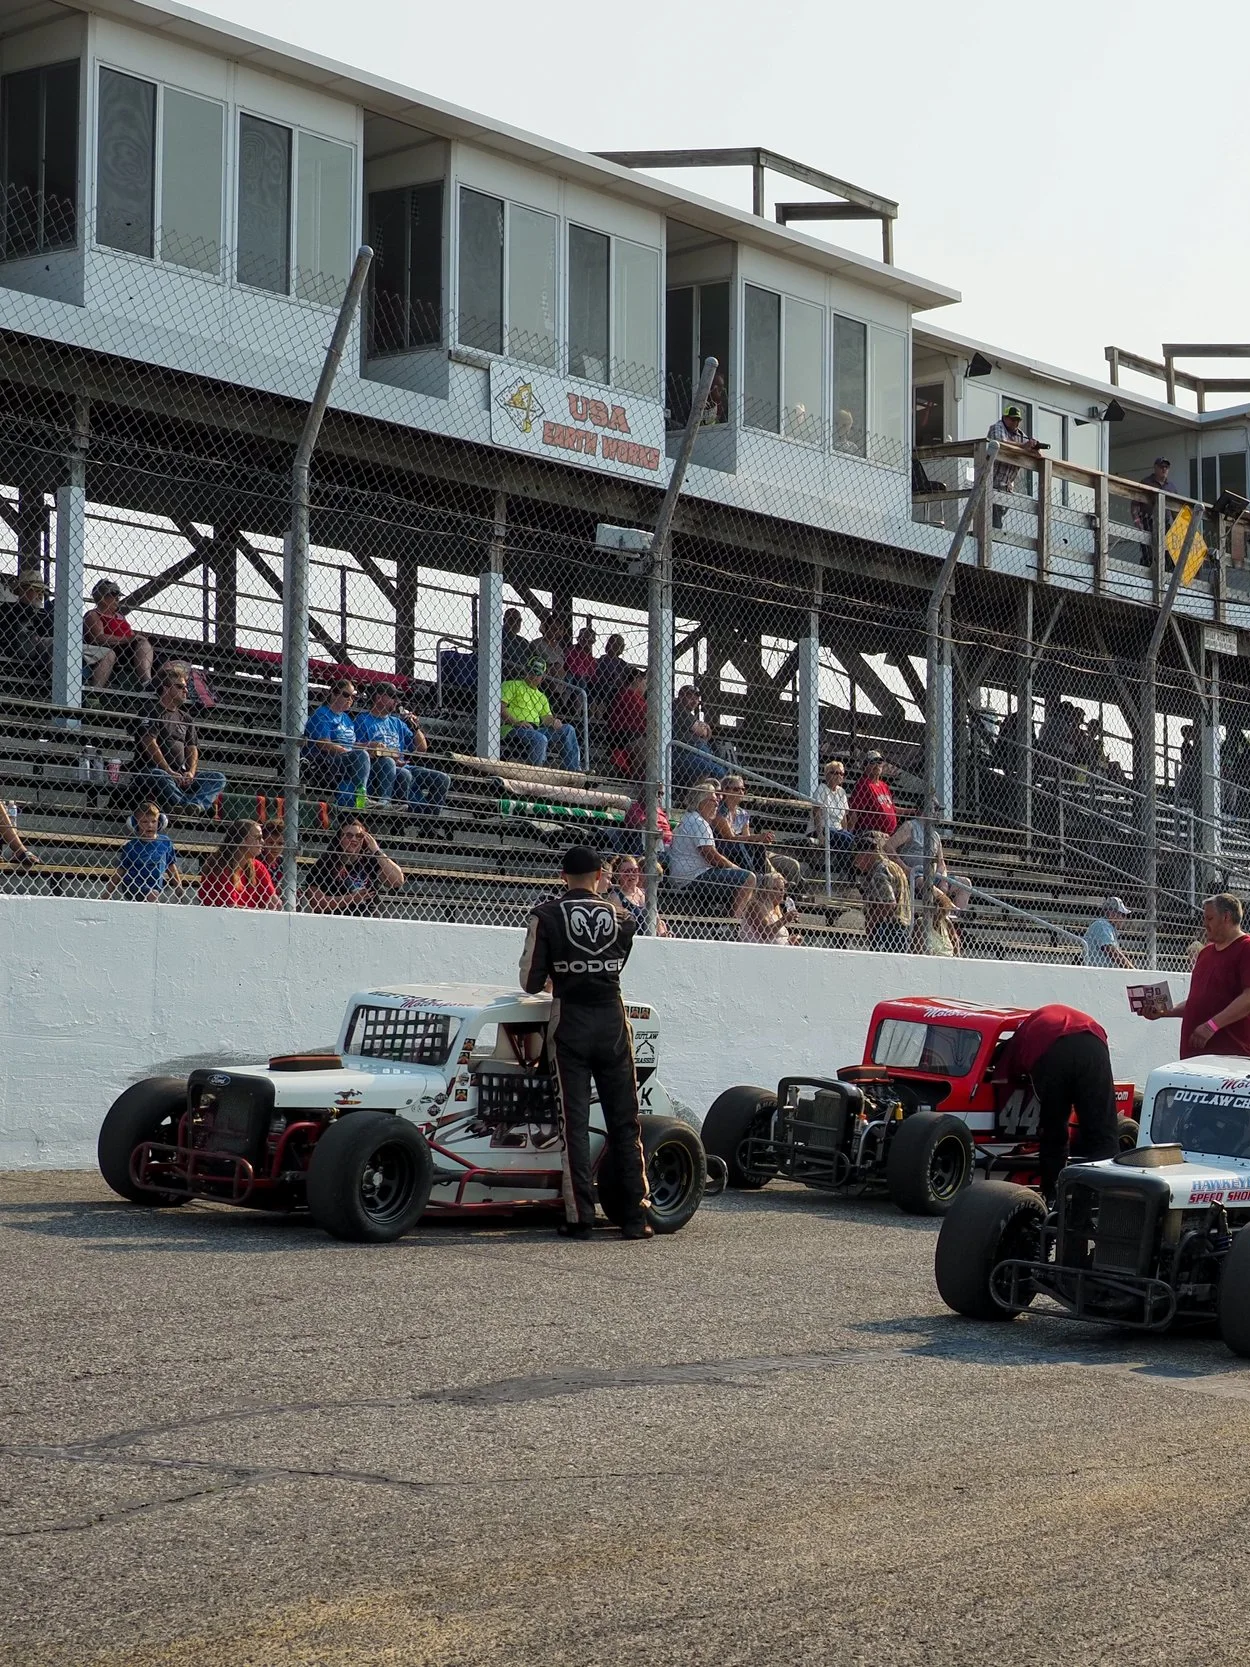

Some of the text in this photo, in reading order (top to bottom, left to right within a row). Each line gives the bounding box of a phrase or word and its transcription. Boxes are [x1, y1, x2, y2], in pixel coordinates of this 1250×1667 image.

[567, 391, 631, 434] USA
[542, 420, 660, 471] EARTH WORKS
[553, 958, 624, 973] DODGE
[999, 1089, 1041, 1135] 44
[1173, 1090, 1234, 1107] OUTLAW
[1188, 1191, 1224, 1204] SPEED
